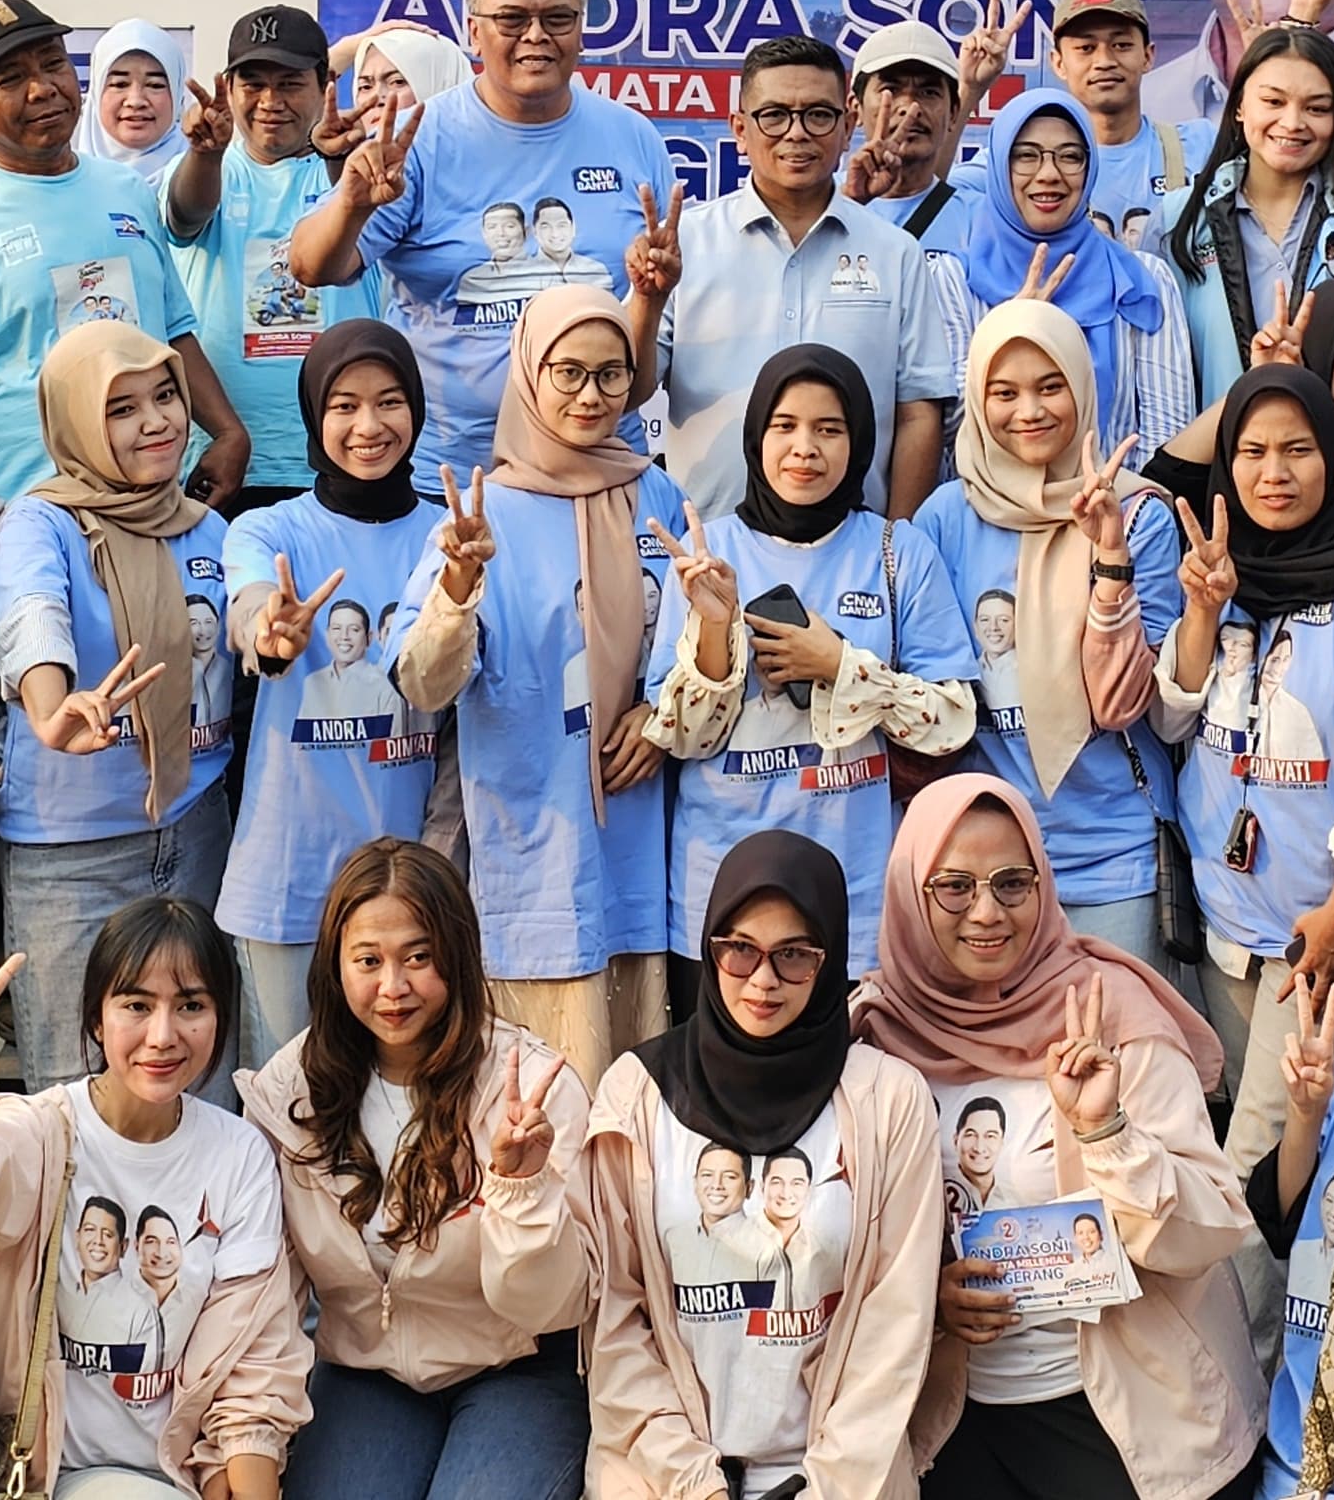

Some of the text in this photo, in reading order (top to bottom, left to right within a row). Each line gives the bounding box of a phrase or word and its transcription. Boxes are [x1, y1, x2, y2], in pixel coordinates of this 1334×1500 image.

[578, 168, 615, 182] CNW
[474, 299, 526, 325] ANDR
[839, 605, 883, 618] BANTEN
[842, 593, 879, 608] CNW
[312, 718, 368, 742] ANDRA
[740, 746, 800, 775] ANDRA
[1249, 757, 1312, 782] DIMYATI
[817, 758, 872, 789] DIMYATI
[1002, 1222, 1014, 1238] 2
[1031, 1240, 1070, 1255] SONI
[678, 1283, 746, 1313] ANDRA
[766, 1309, 823, 1338] DIMYA
